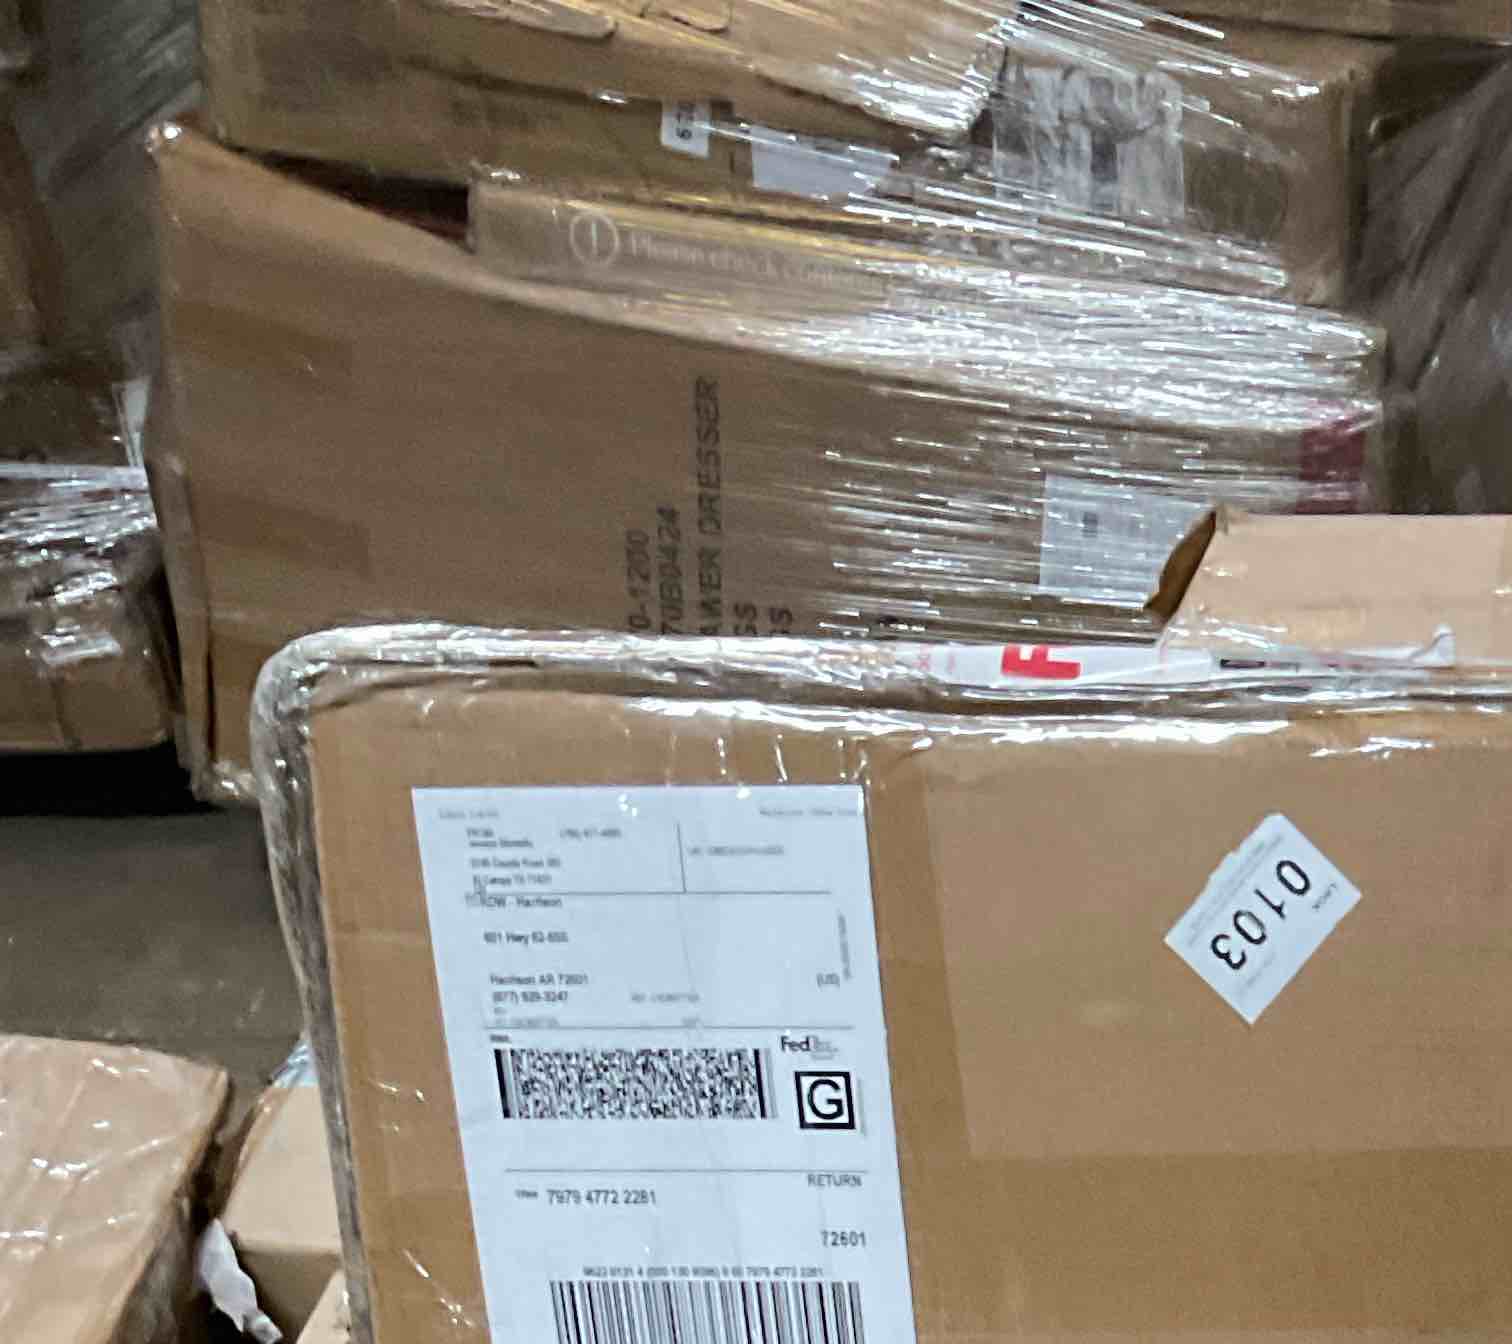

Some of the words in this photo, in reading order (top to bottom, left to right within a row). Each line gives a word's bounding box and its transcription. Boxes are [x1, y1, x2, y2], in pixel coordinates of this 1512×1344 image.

[694, 376, 722, 536] DRESSER
[1210, 859, 1311, 970] 0103
[505, 931, 529, 948] Hwy
[539, 973, 554, 984] AR
[807, 1078, 844, 1120] G
[807, 1175, 862, 1188] RETURN
[585, 1190, 618, 1204] 4772
[623, 1190, 657, 1204] 2281
[820, 1230, 867, 1247] 72601
